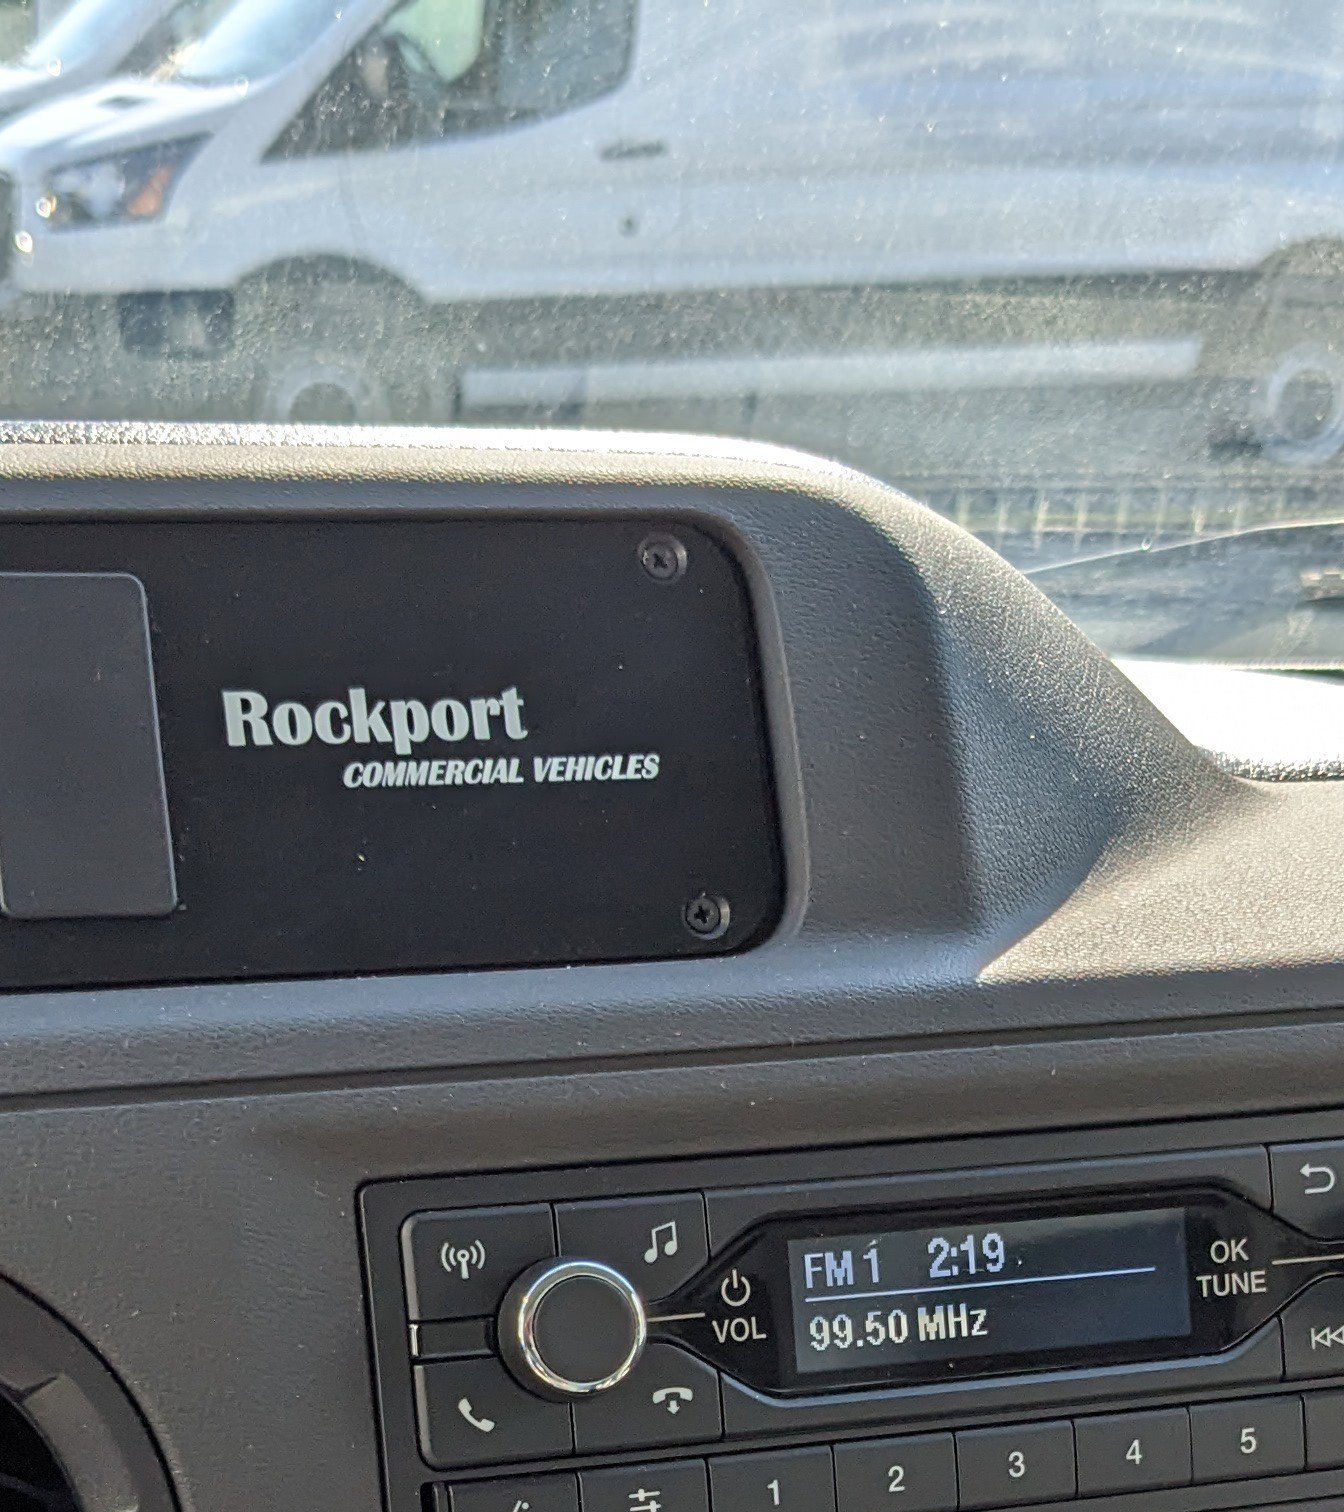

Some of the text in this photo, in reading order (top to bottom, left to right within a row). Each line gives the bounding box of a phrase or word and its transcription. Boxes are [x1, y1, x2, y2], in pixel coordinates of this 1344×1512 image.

[221, 687, 529, 755] Rockport
[343, 753, 660, 789] COMMERCIAL VEHICLES
[804, 1249, 854, 1289] FM
[927, 1232, 1005, 1278] 2:19
[1209, 1238, 1250, 1264] OK
[1196, 1269, 1267, 1299] TUNE
[712, 1316, 767, 1343] VOL
[809, 1302, 989, 1351] 99.50 MHz
[767, 1479, 782, 1506] 1
[887, 1465, 906, 1493] 2
[1007, 1451, 1026, 1479] 3
[1125, 1439, 1143, 1466] 4
[1239, 1427, 1257, 1455] 5
